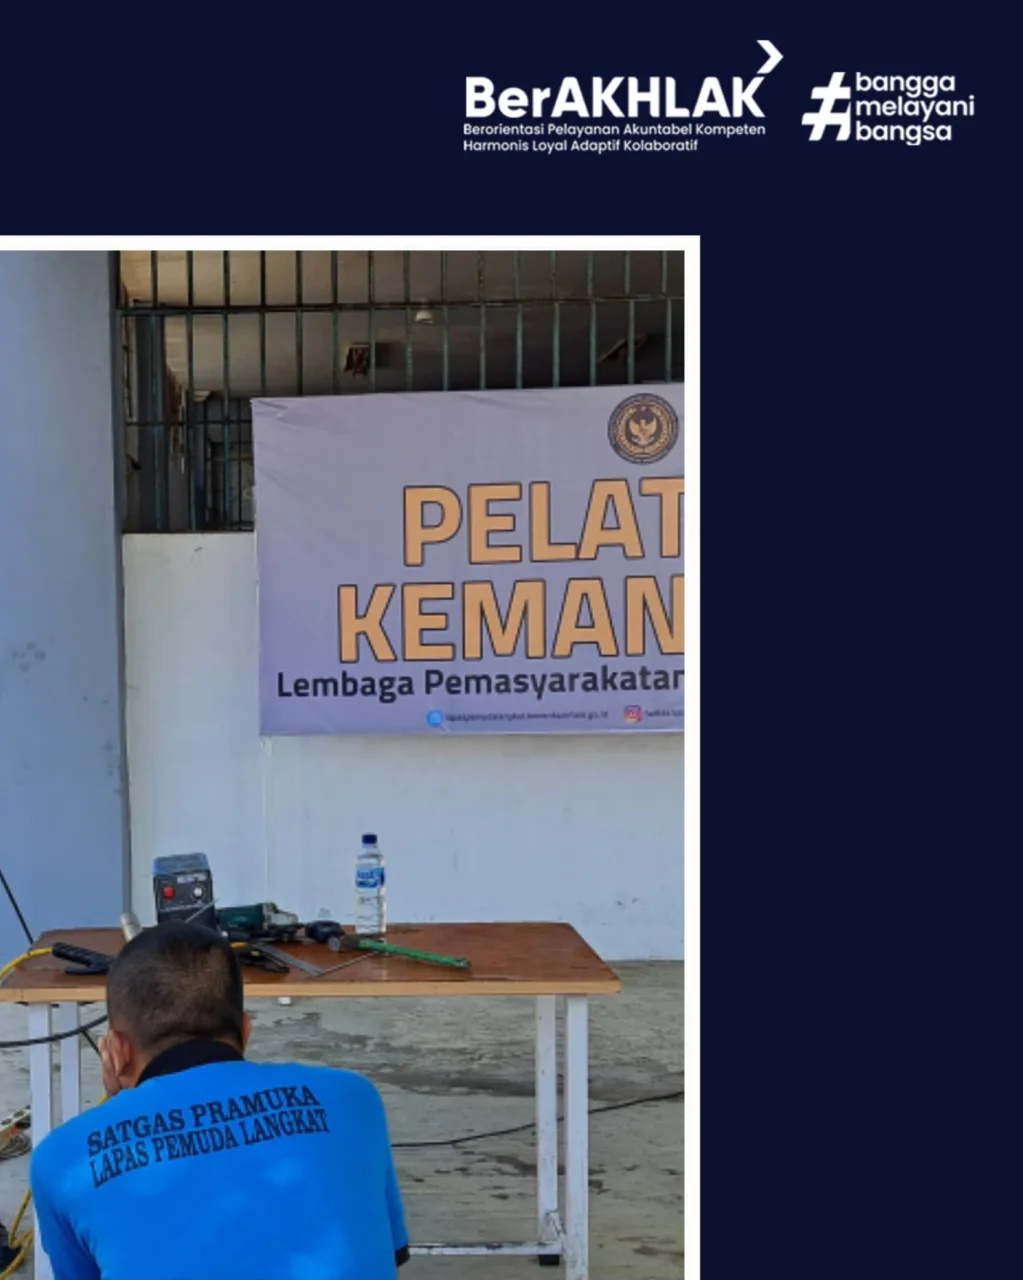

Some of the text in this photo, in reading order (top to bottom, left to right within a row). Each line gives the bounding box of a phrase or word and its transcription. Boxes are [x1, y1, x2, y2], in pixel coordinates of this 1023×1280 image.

[277, 670, 415, 704] Lembaga
[87, 1085, 321, 1157] SATGAS PRAMUKA
[89, 1108, 331, 1188] LAPAS PEMUDA LANGKAT
